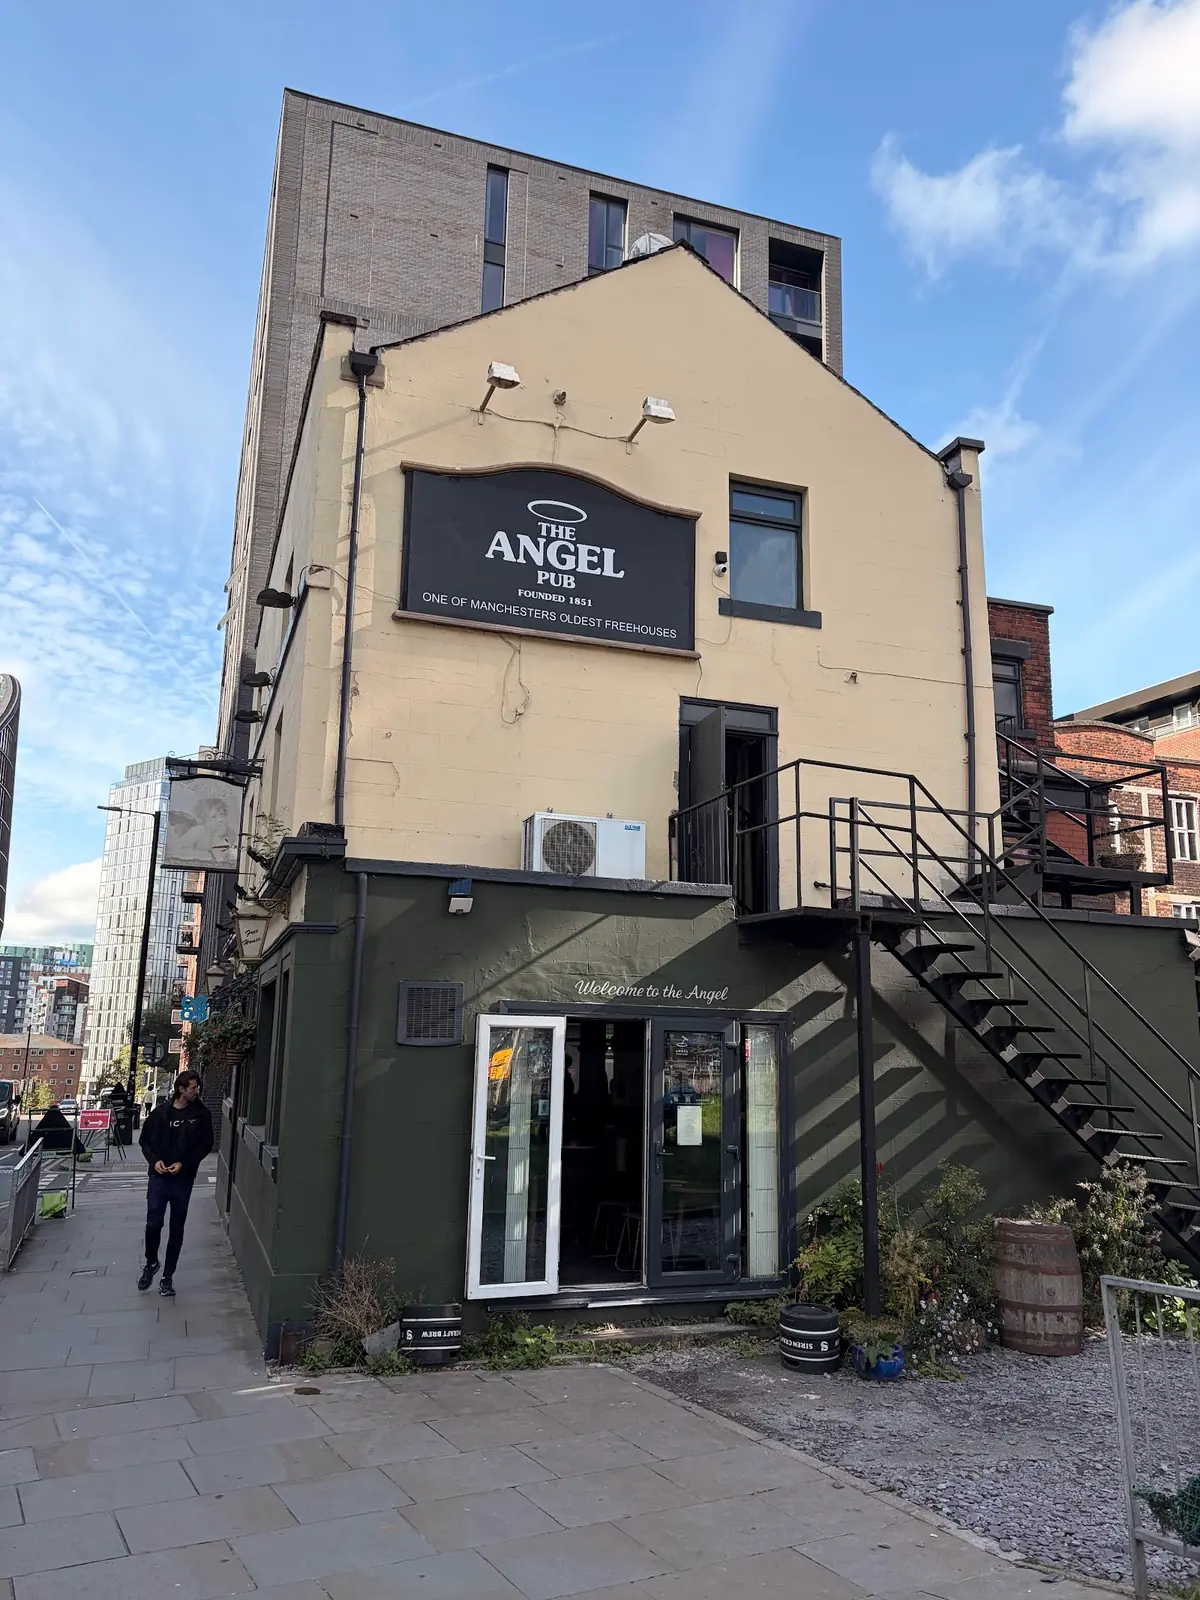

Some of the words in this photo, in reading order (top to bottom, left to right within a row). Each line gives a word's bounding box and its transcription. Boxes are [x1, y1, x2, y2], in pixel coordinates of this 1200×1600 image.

[537, 521, 577, 541] THE
[485, 530, 625, 579] ANGEL
[536, 570, 576, 589] PUB
[517, 588, 566, 603] FOUNDED
[568, 596, 593, 607] 1851
[422, 591, 448, 605] ONE
[451, 596, 468, 607] OF
[470, 599, 557, 621] MANCHESTERS
[559, 613, 603, 628] OLDEST
[604, 619, 678, 639] FREEHOUSES
[574, 980, 643, 997] Welcome
[646, 984, 660, 998] to
[662, 983, 683, 999] the
[684, 985, 730, 1005] Angel
[421, 1330, 442, 1338] BREW
[780, 1336, 793, 1347] CRA
[793, 1341, 814, 1350] SIREN
